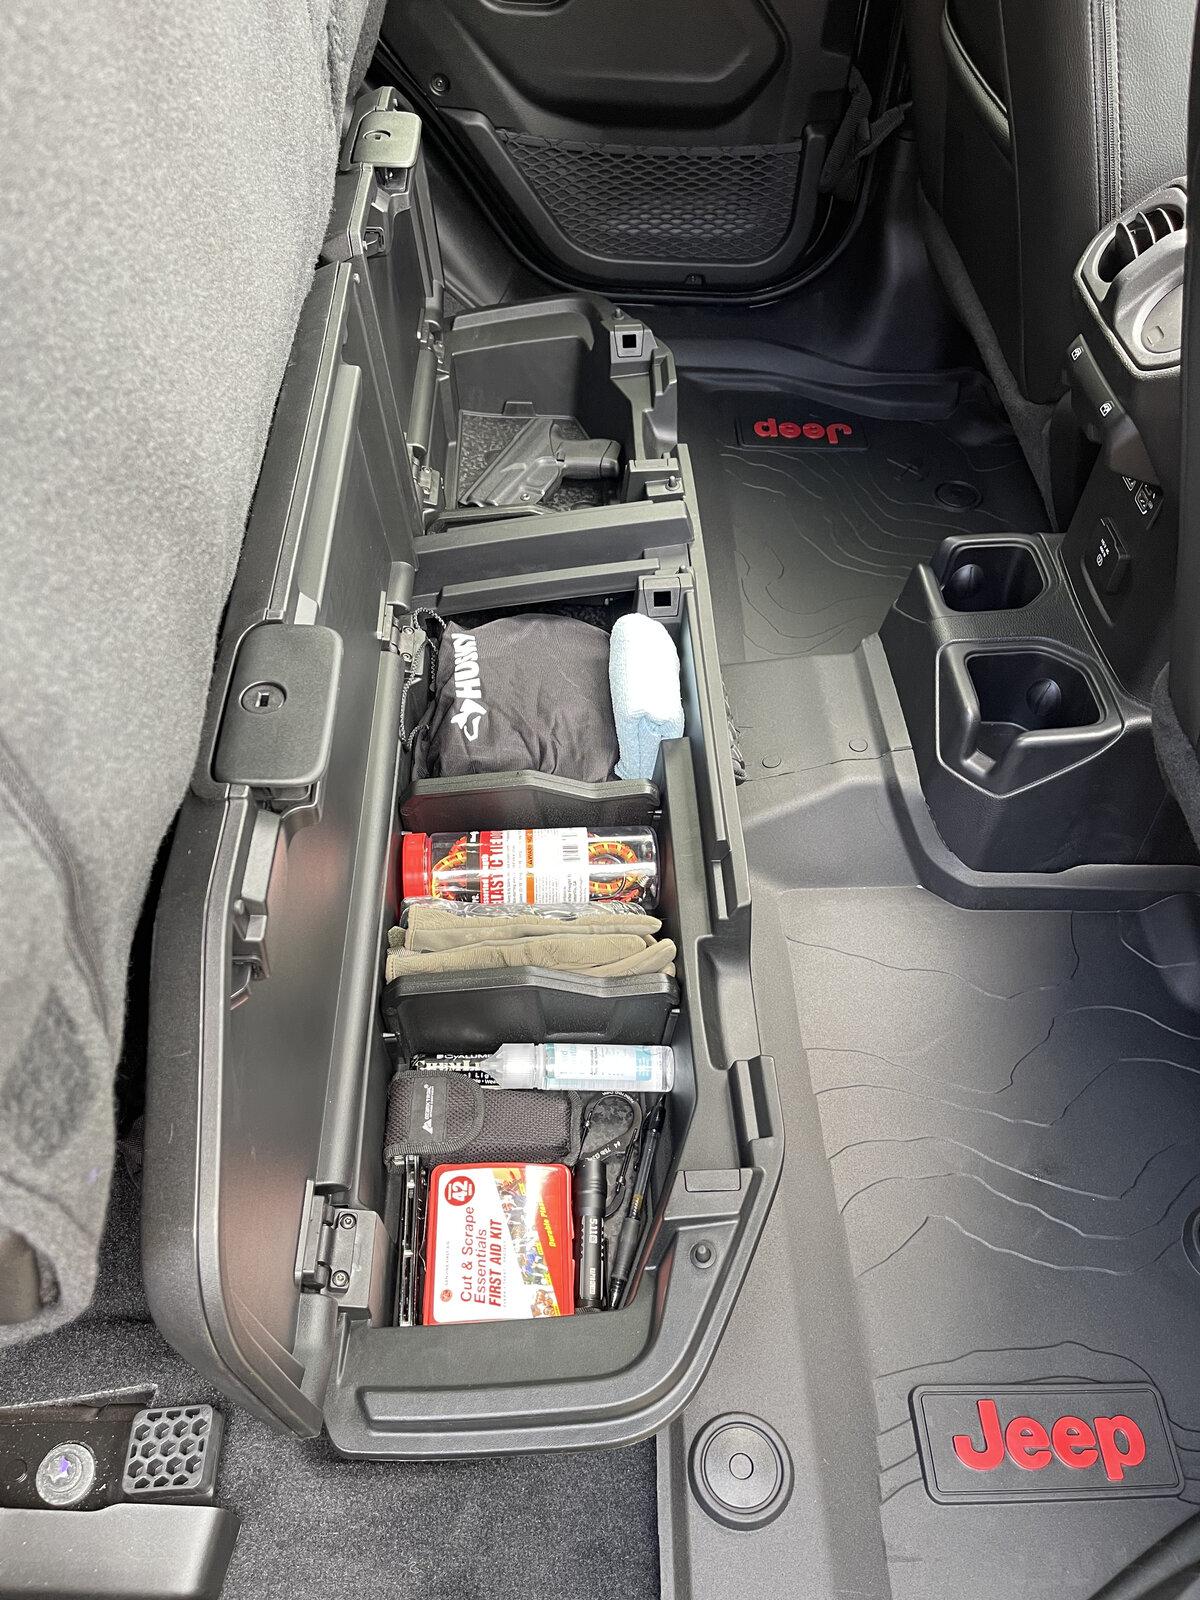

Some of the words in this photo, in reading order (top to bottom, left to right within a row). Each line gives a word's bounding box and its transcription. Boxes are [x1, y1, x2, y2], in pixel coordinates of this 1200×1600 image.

[753, 417, 853, 444] Jeep
[451, 632, 482, 699] HUSKY
[452, 1180, 469, 1202] 42
[461, 1206, 476, 1256] Scrape
[489, 1218, 502, 1239] KIT
[543, 1218, 557, 1248] Durable
[461, 1260, 473, 1271] &
[474, 1228, 487, 1304] Essentials
[489, 1242, 502, 1265] AID
[460, 1275, 473, 1302] Cut
[489, 1268, 502, 1307] FIRST
[951, 1398, 1147, 1482] Jeep
